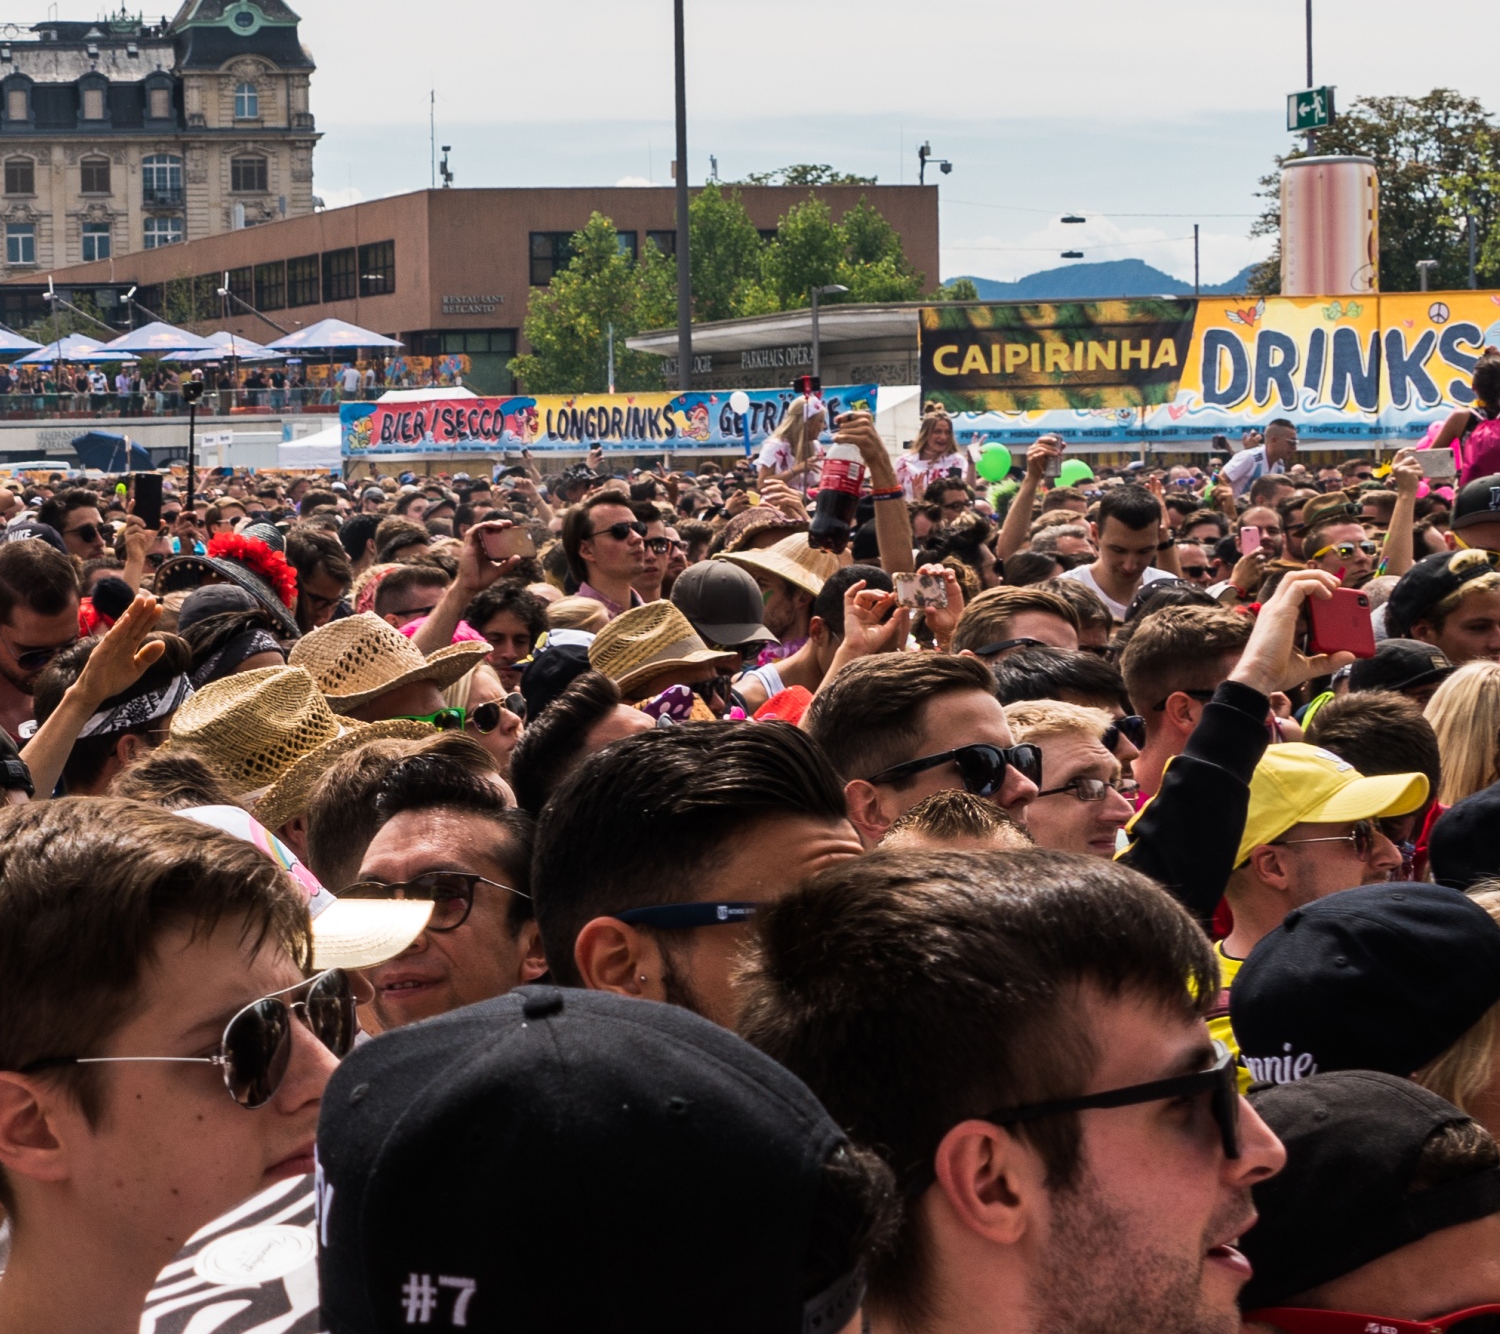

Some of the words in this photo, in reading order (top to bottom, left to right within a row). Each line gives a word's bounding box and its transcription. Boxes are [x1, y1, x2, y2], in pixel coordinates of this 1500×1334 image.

[741, 349, 784, 369] PARKHAUS
[932, 338, 1178, 376] CAIPIRINHA
[1201, 322, 1486, 412] DRINKS
[546, 404, 677, 442] LONGDRINKS
[8, 529, 32, 541] NIKE
[402, 1273, 477, 1327] #7
